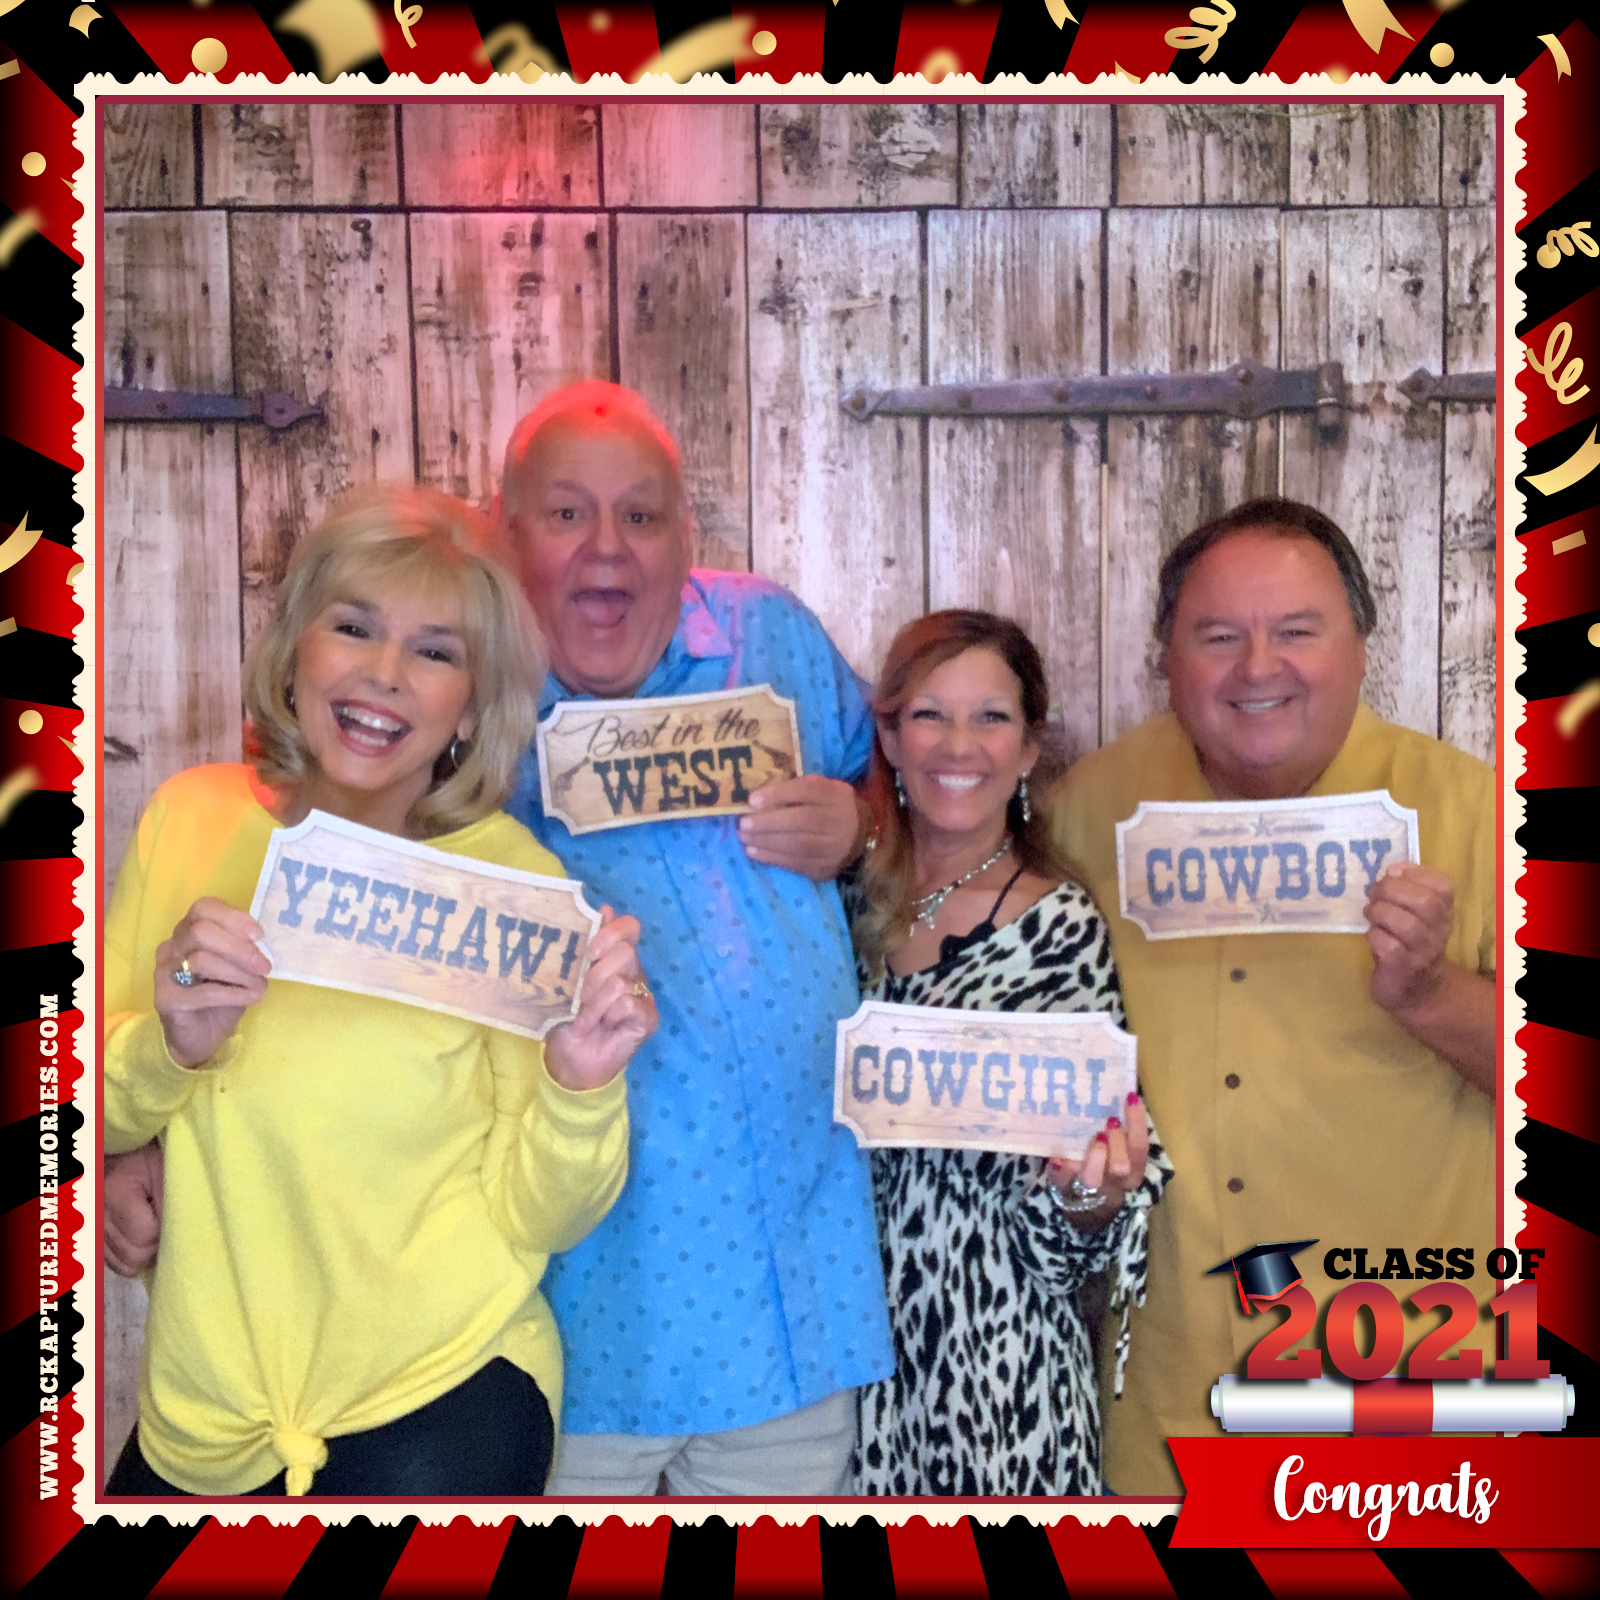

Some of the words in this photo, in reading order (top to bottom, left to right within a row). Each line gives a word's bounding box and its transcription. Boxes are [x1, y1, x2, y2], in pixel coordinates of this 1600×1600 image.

[562, 713, 671, 757] Best
[671, 719, 704, 747] in
[713, 707, 762, 743] the
[593, 745, 753, 816] WEST
[1145, 838, 1392, 907] COWBOY
[277, 857, 580, 997] YEEHAW!
[851, 1044, 1119, 1118] COWGIRL
